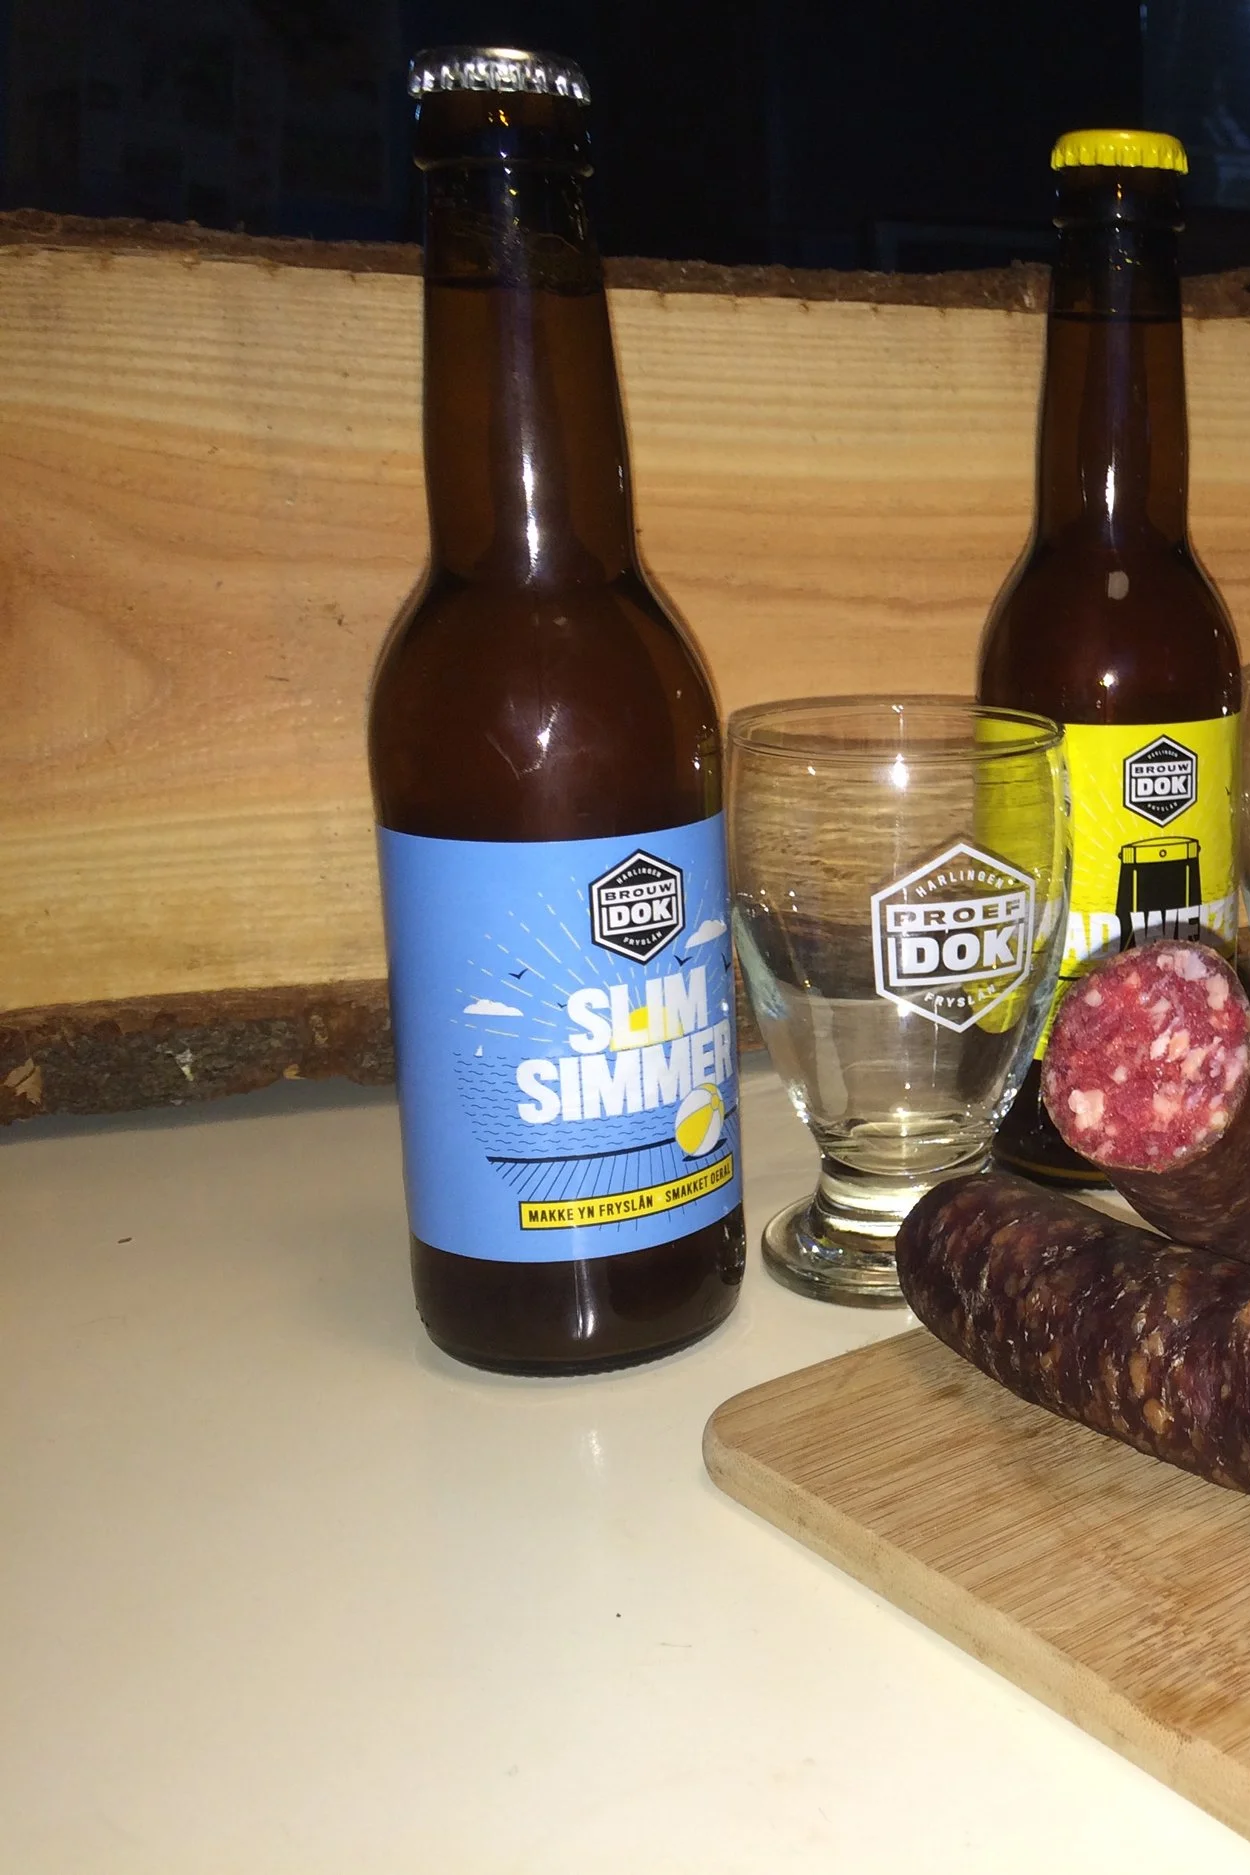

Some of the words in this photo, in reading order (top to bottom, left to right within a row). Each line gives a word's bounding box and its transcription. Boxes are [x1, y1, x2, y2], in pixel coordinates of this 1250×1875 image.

[1135, 763, 1189, 774] BROUW
[1137, 775, 1187, 796] DOK
[605, 882, 672, 901] BROUW
[915, 870, 1005, 898] HARLINGEN
[609, 897, 672, 928] DOK
[893, 898, 1020, 926] PROEF
[902, 925, 1017, 974] DOK
[568, 967, 710, 1053] SLIM
[516, 1020, 734, 1124] SIMMER
[528, 1207, 574, 1222] MAKKE
[578, 1204, 595, 1219] YN
[665, 1177, 709, 1202] SMAKKET
[710, 1167, 731, 1185] OERAL
